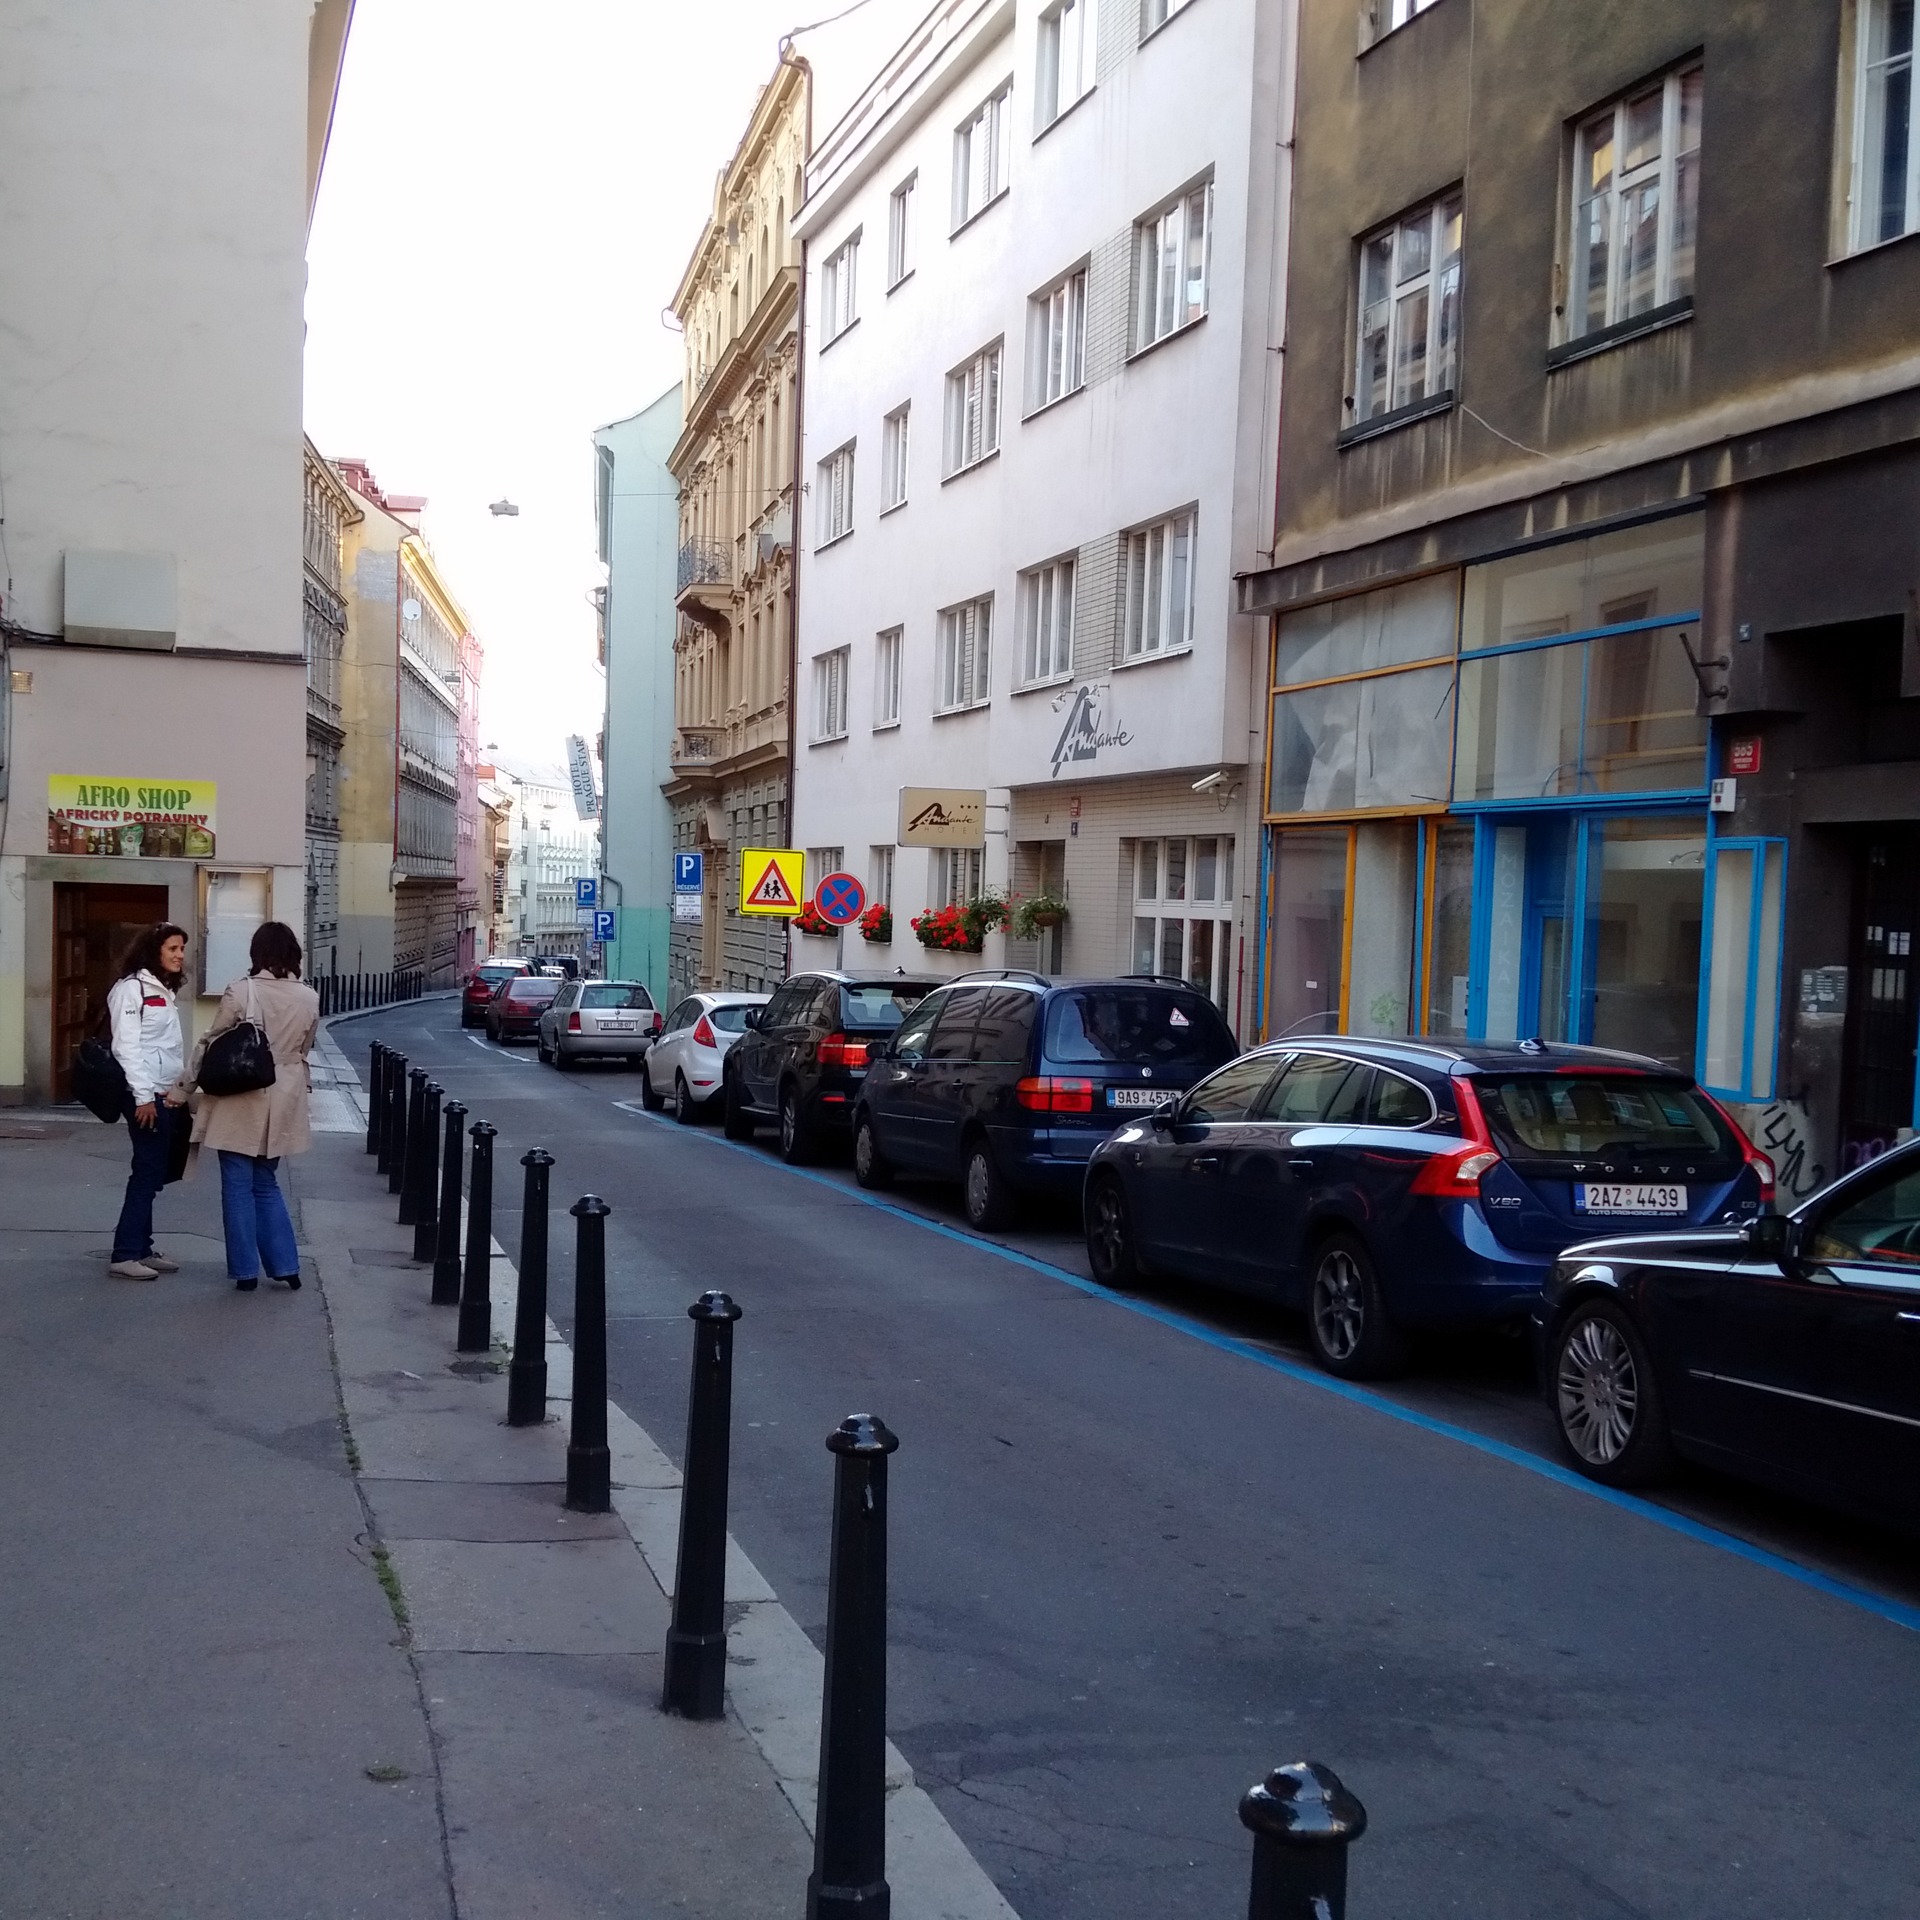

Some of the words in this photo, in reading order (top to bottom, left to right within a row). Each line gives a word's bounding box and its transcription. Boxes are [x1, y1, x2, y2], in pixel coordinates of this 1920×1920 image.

[576, 740, 588, 767] STAR
[570, 760, 583, 796] HOTEL
[76, 784, 131, 808] AFRO
[137, 787, 192, 811] SHOP
[581, 771, 596, 813] PRAGUE
[55, 808, 120, 823] AFRICKÝ
[123, 811, 209, 826] POTRAVINY
[908, 802, 978, 832] Andante
[924, 827, 979, 835] HOTEL
[682, 856, 695, 879] P
[580, 881, 593, 899] P
[597, 913, 611, 932] P
[1499, 854, 1518, 985] MOZAIKA
[1117, 1091, 1140, 1104] 9A9
[1573, 1164, 1696, 1175] VOLVO
[1489, 1196, 1522, 1206] V60
[1590, 1186, 1623, 1207] 2AZ
[1636, 1188, 1679, 1207] 4439
